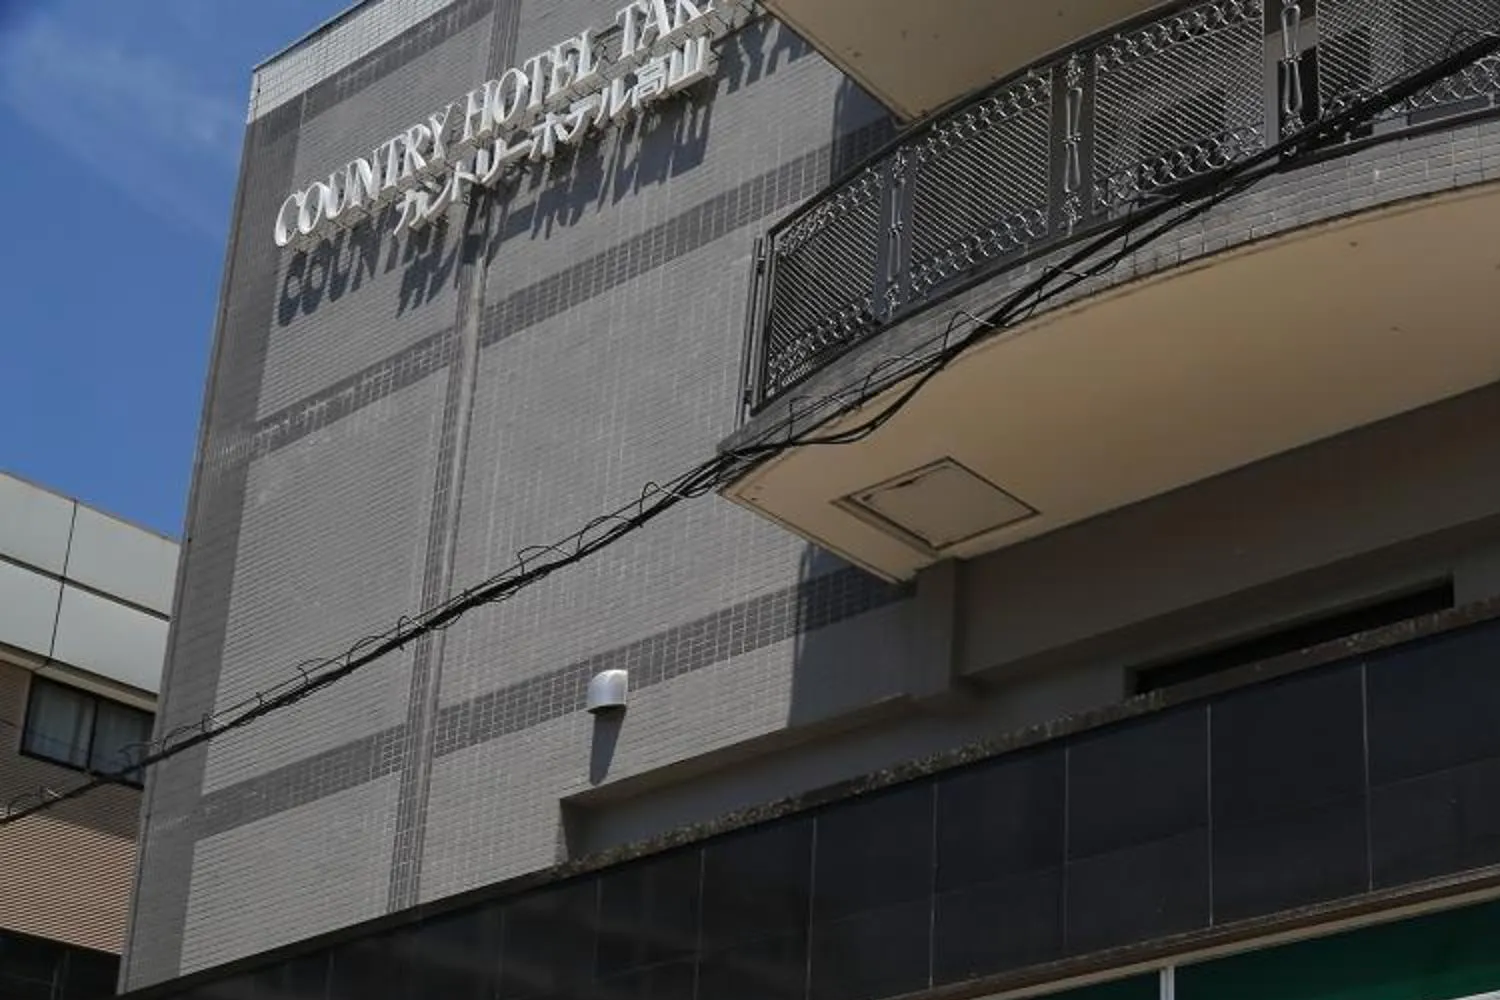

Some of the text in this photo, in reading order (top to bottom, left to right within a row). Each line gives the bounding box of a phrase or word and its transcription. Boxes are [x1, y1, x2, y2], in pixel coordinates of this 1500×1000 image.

[274, 0, 717, 247] COUNTRY HOTEL TAK
[393, 35, 709, 236] カントリーホテル高山
